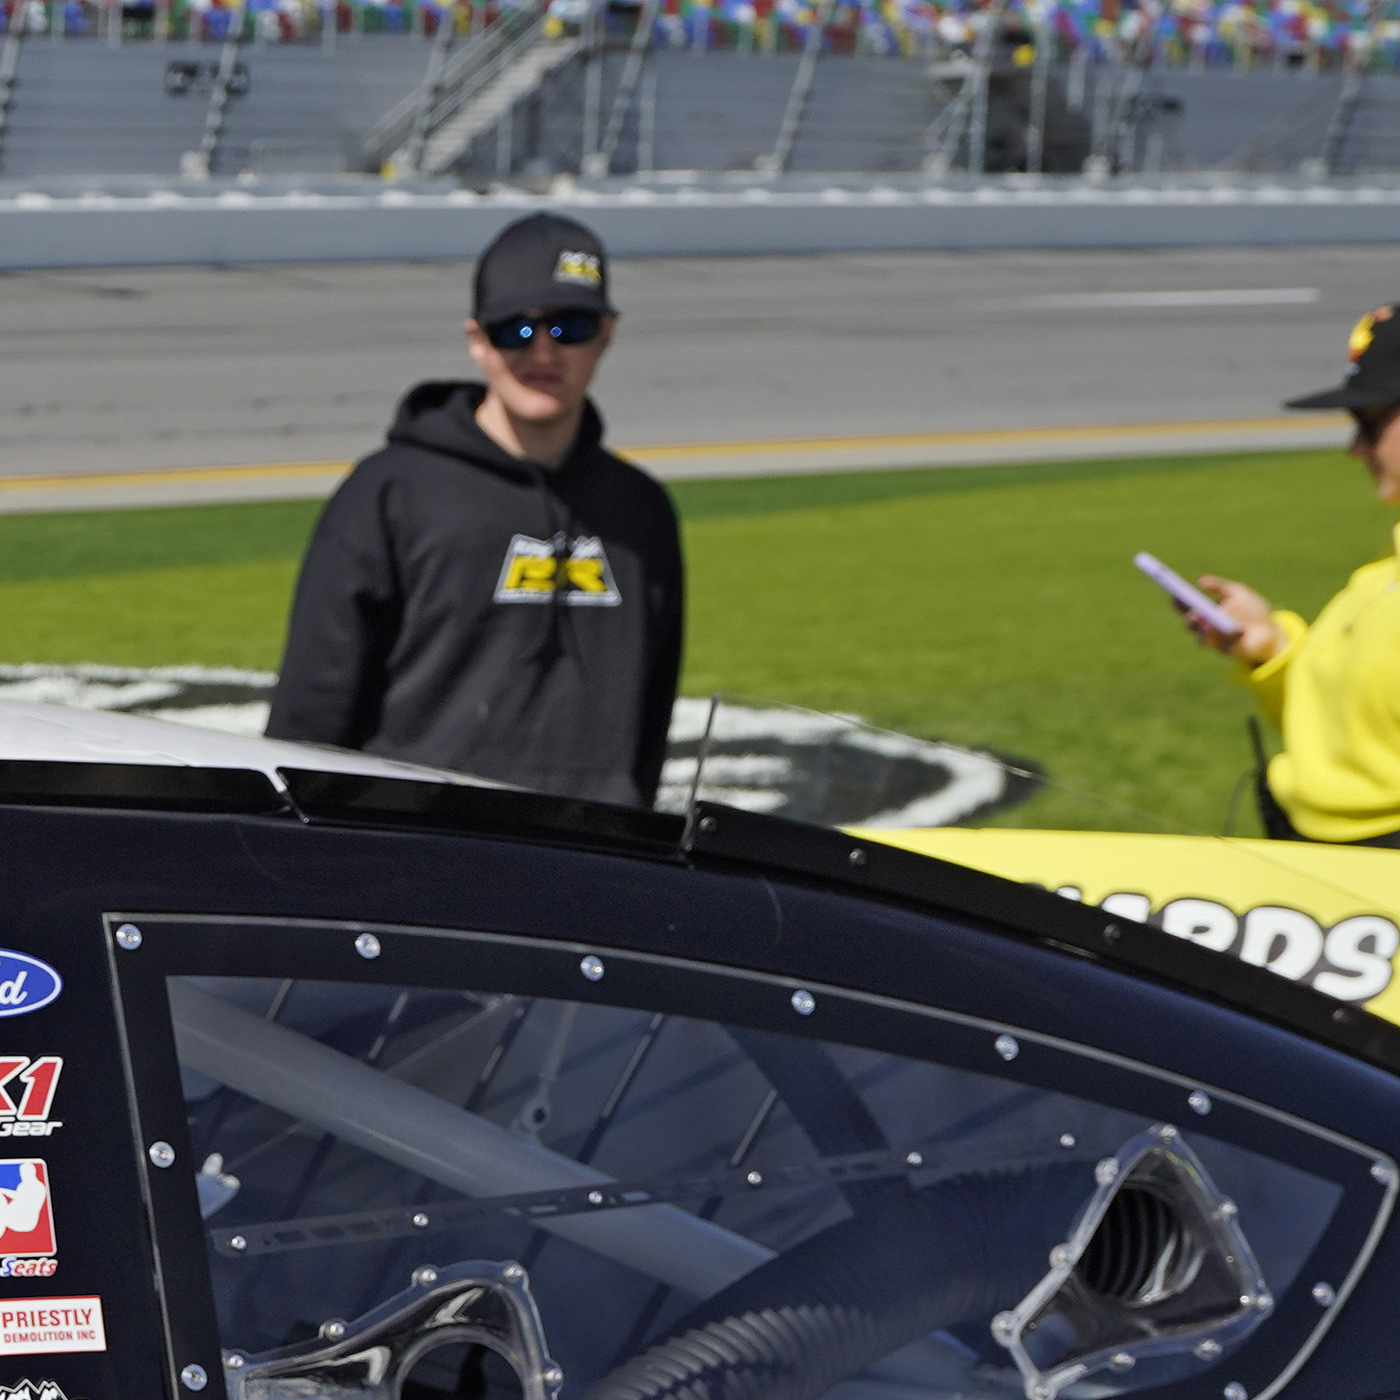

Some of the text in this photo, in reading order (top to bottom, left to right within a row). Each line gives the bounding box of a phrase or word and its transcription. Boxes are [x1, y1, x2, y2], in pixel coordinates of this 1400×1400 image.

[0, 1257, 57, 1277] Seats
[2, 1308, 93, 1328] PRIESTLY
[4, 1330, 95, 1343] DEMOLITION INC
